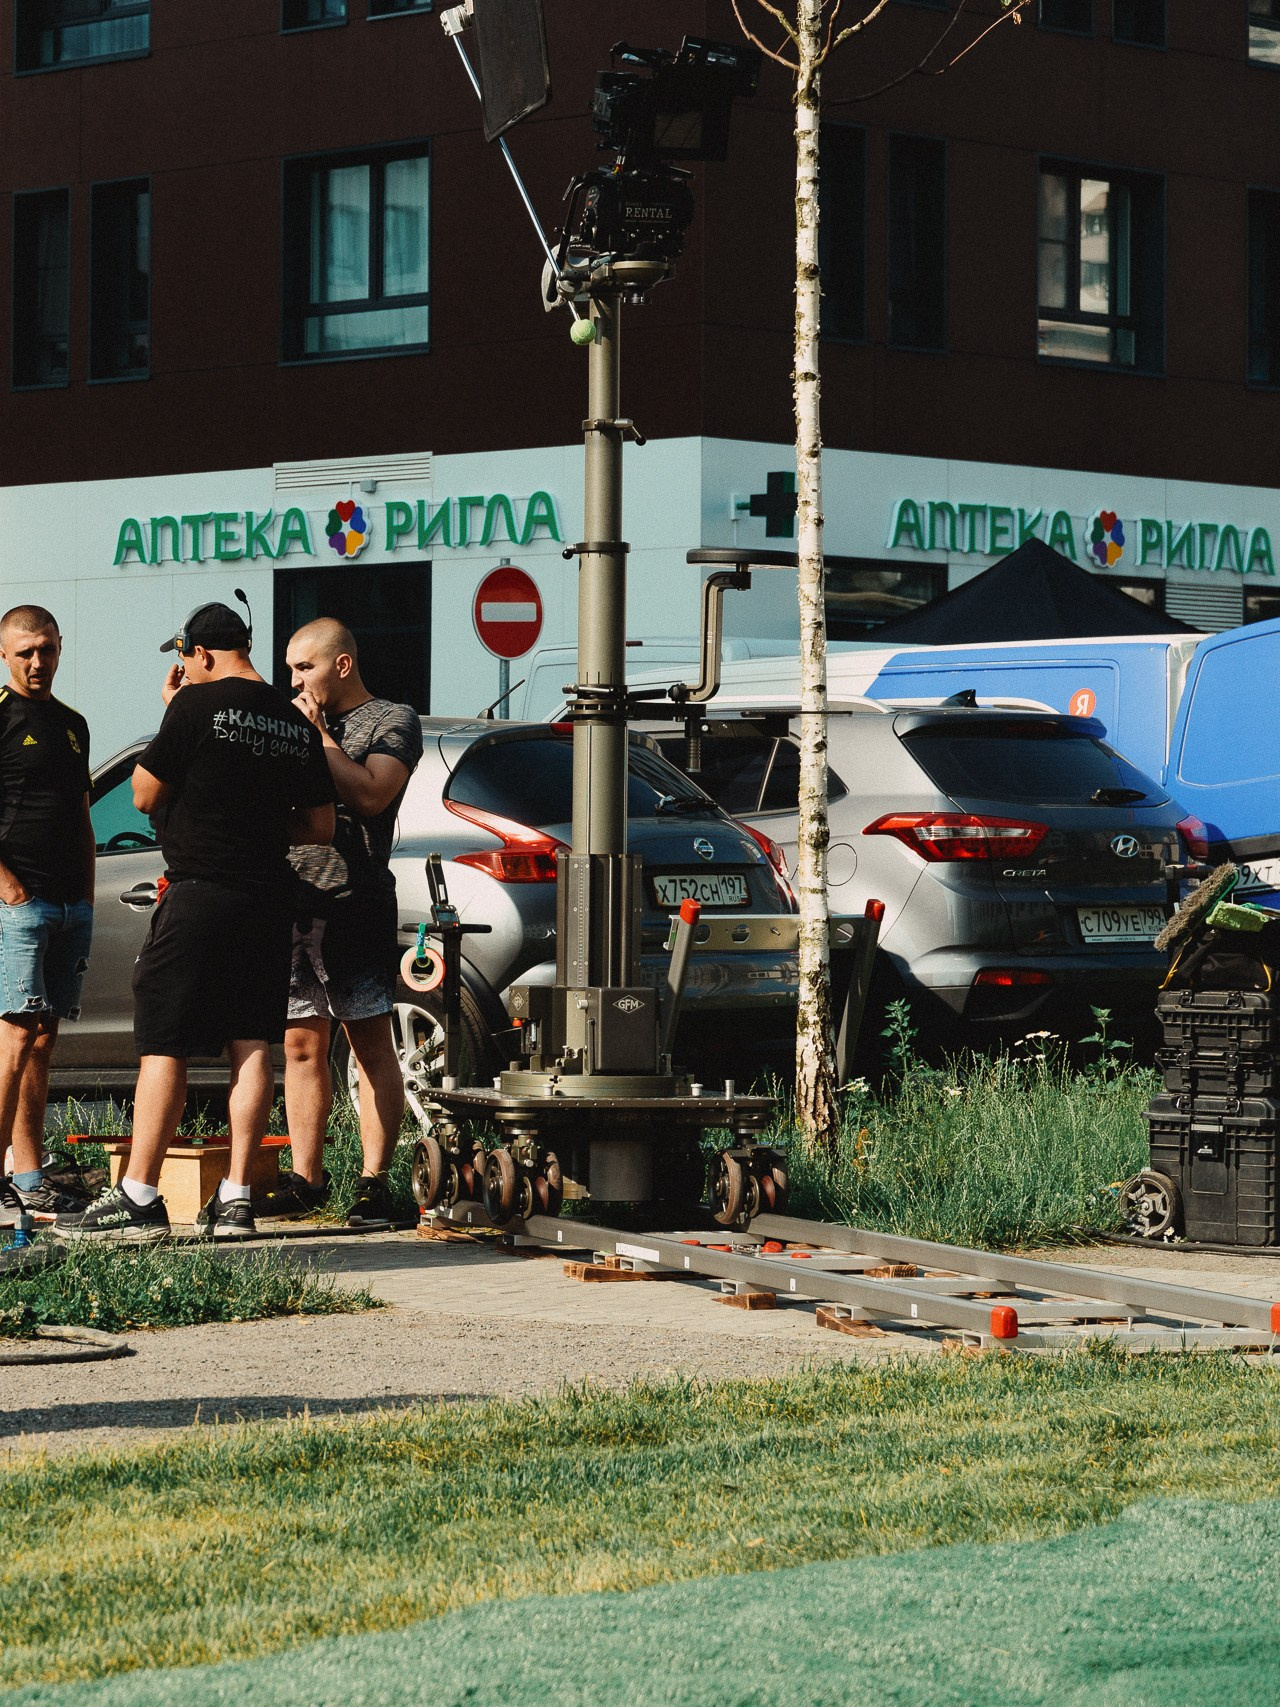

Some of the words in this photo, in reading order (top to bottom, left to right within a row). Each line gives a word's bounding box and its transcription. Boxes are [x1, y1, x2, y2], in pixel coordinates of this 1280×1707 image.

[625, 207, 672, 219] RENTAL
[113, 507, 315, 566] АПТЕКА
[384, 491, 564, 551] РИГЛА
[886, 499, 1078, 561] АПТЕКА
[1135, 518, 1276, 576] РИГЛА
[213, 708, 310, 744] #KASHIN'S
[213, 725, 265, 756] Dolly
[270, 739, 310, 765] gang
[1003, 869, 1047, 877] CRETA
[617, 999, 639, 1010] GFM
